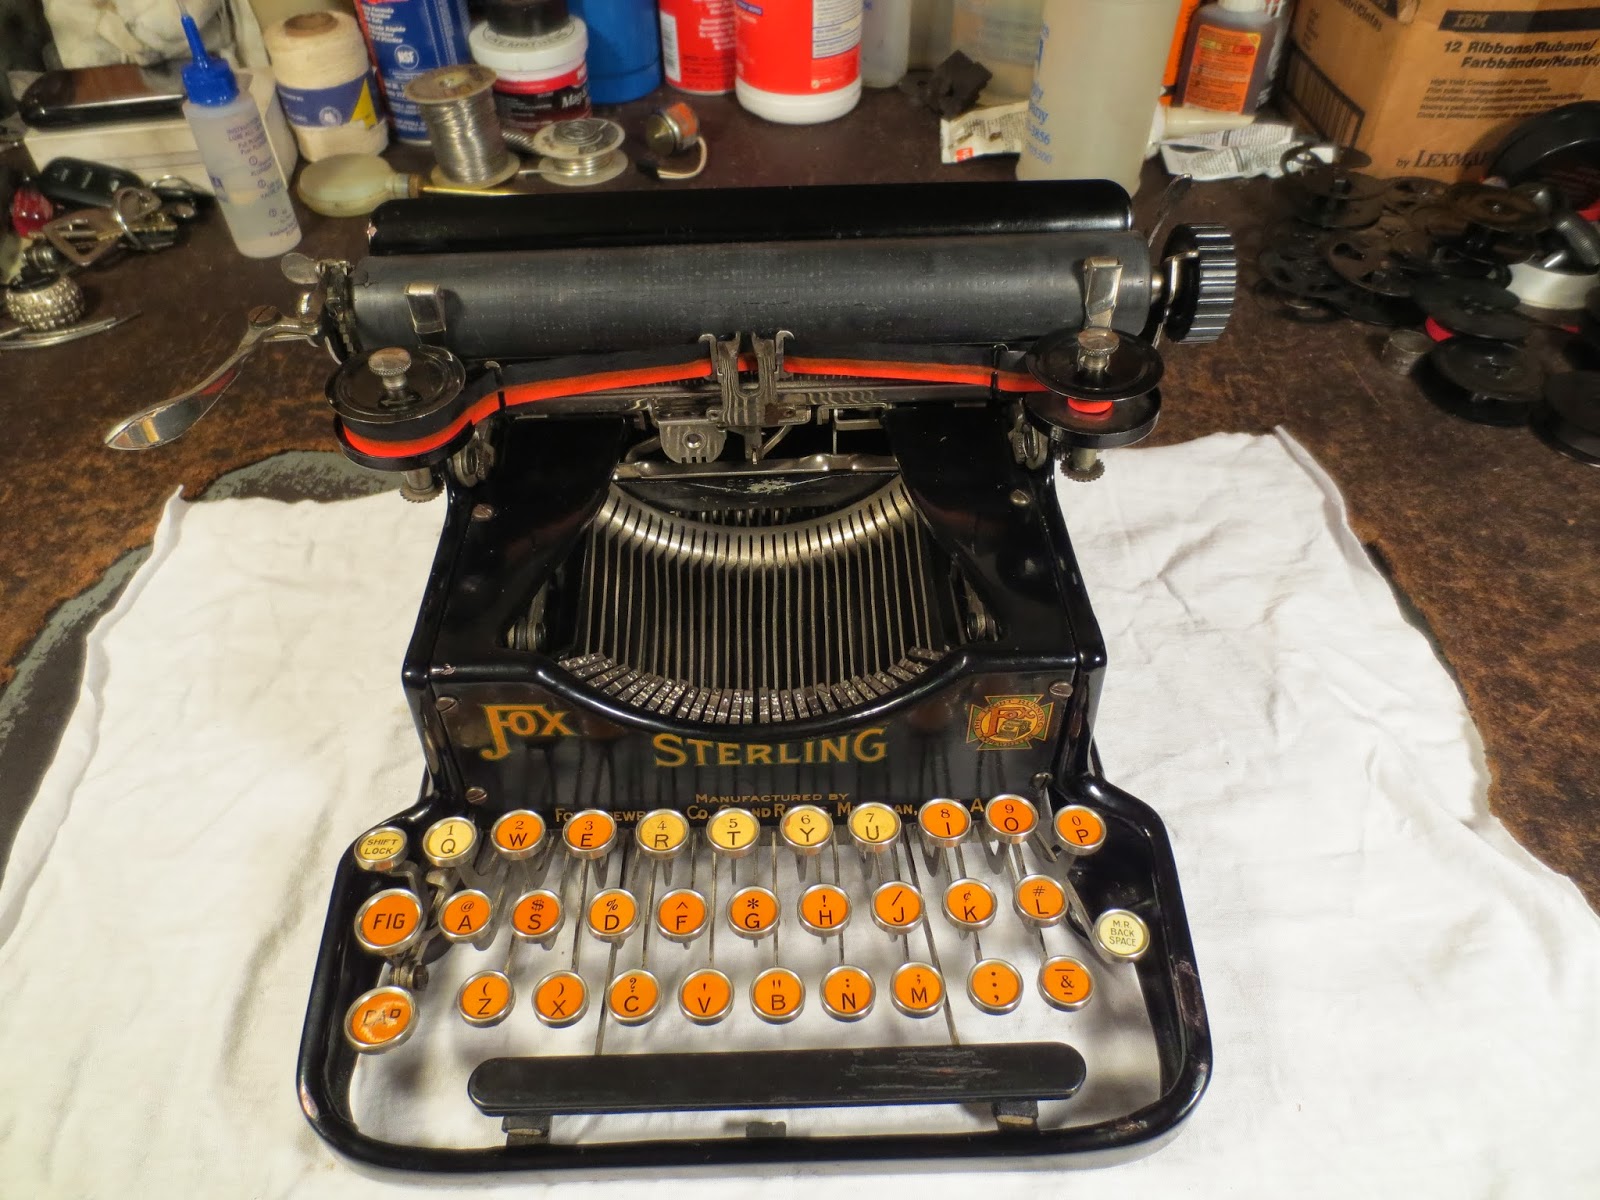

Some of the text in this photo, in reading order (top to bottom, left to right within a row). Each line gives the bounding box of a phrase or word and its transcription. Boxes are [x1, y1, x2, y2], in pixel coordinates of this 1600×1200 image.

[1453, 14, 1489, 28] IBM
[1443, 38, 1597, 55] 12 Ribbons/Rubans/
[397, 50, 415, 63] NSF
[1396, 158, 1410, 169] by
[652, 726, 888, 768] STERLING
[695, 793, 849, 804] MANUFACTURED BY
[940, 808, 950, 819] 8
[1004, 804, 1014, 814] 9
[515, 820, 525, 830] 2
[584, 820, 594, 831] 3
[657, 820, 668, 831] 4
[728, 818, 738, 829] 5
[801, 814, 811, 825] 6
[865, 813, 875, 823] 7
[1004, 817, 1019, 832] O
[1071, 815, 1082, 826] 0
[447, 825, 454, 836] 1
[800, 827, 815, 842] Y
[865, 825, 879, 841] U
[946, 822, 951, 836] I
[1076, 828, 1089, 843] P
[367, 838, 399, 846] SHIFT
[440, 838, 456, 854] Q
[509, 832, 528, 847] W
[580, 833, 593, 847] E
[654, 834, 669, 848] R
[727, 831, 741, 846] T
[364, 847, 393, 855] LOCK
[1033, 885, 1045, 897] #
[460, 901, 474, 912] @
[531, 898, 544, 912] $
[606, 899, 618, 911] %
[1035, 899, 1050, 915] L
[744, 913, 760, 929] G
[819, 910, 833, 925] H
[893, 907, 905, 923] J
[963, 906, 978, 921] K
[373, 913, 406, 930] FIG
[457, 915, 472, 931] A
[527, 914, 541, 930] S
[604, 914, 620, 931] D
[676, 915, 688, 931] F
[1110, 928, 1136, 937] BACK
[1109, 935, 1137, 947] SPACE
[629, 977, 637, 993] ?
[1060, 975, 1075, 989] &
[771, 995, 786, 1011] B
[841, 992, 856, 1010] N
[910, 987, 928, 1004] M
[477, 998, 492, 1015] Z
[551, 1000, 566, 1016] X
[624, 995, 639, 1013] C
[697, 997, 711, 1014] V
